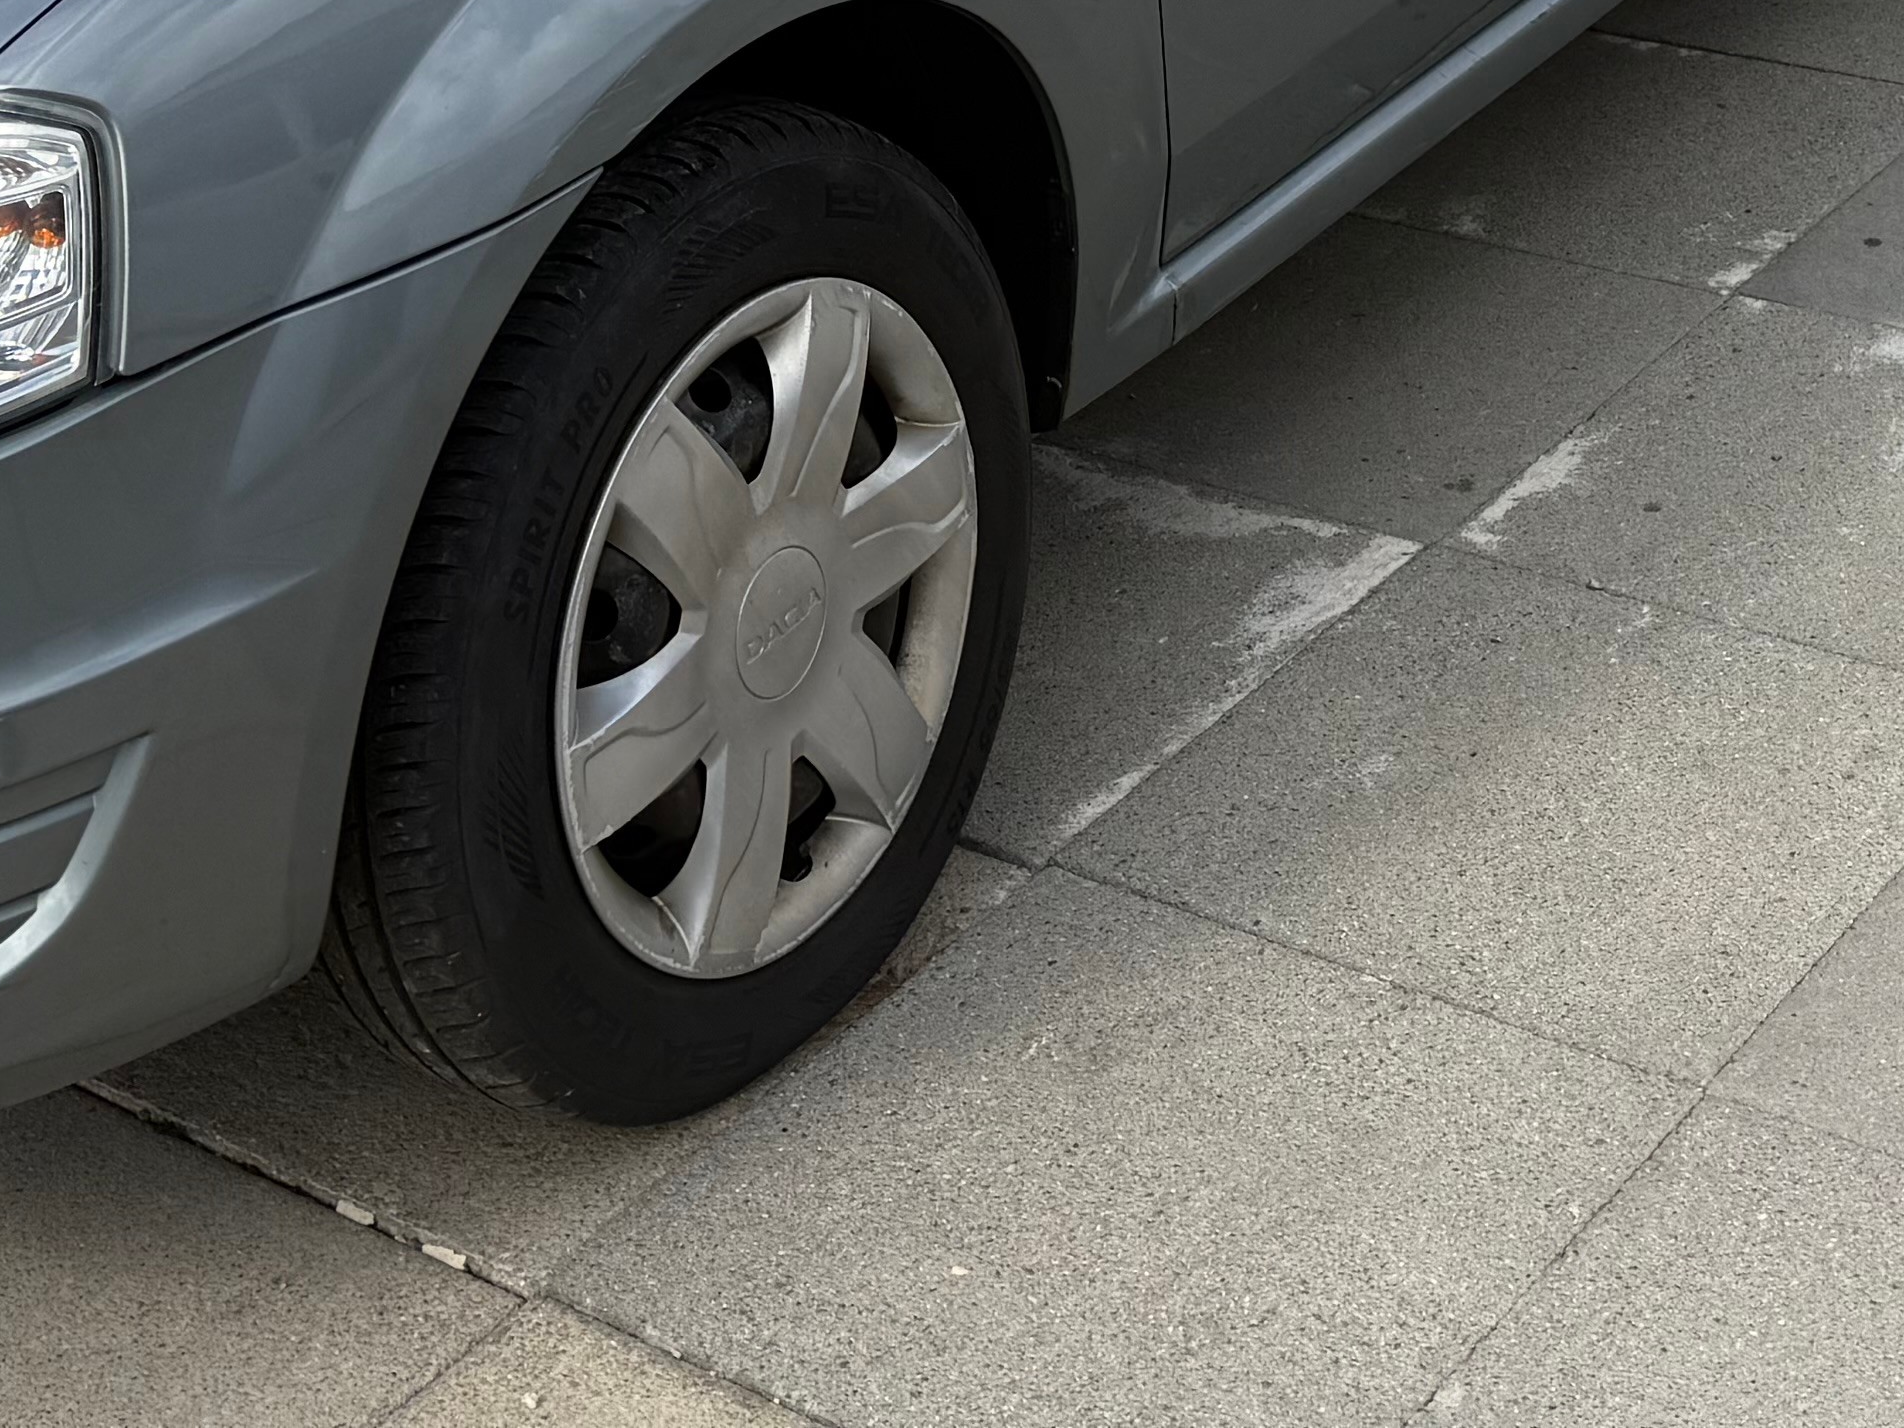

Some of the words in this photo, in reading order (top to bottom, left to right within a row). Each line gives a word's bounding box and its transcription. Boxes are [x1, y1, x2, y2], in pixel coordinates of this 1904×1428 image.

[502, 466, 565, 625] SPIRIT
[560, 366, 614, 454] PRO
[746, 586, 823, 665] DACIA
